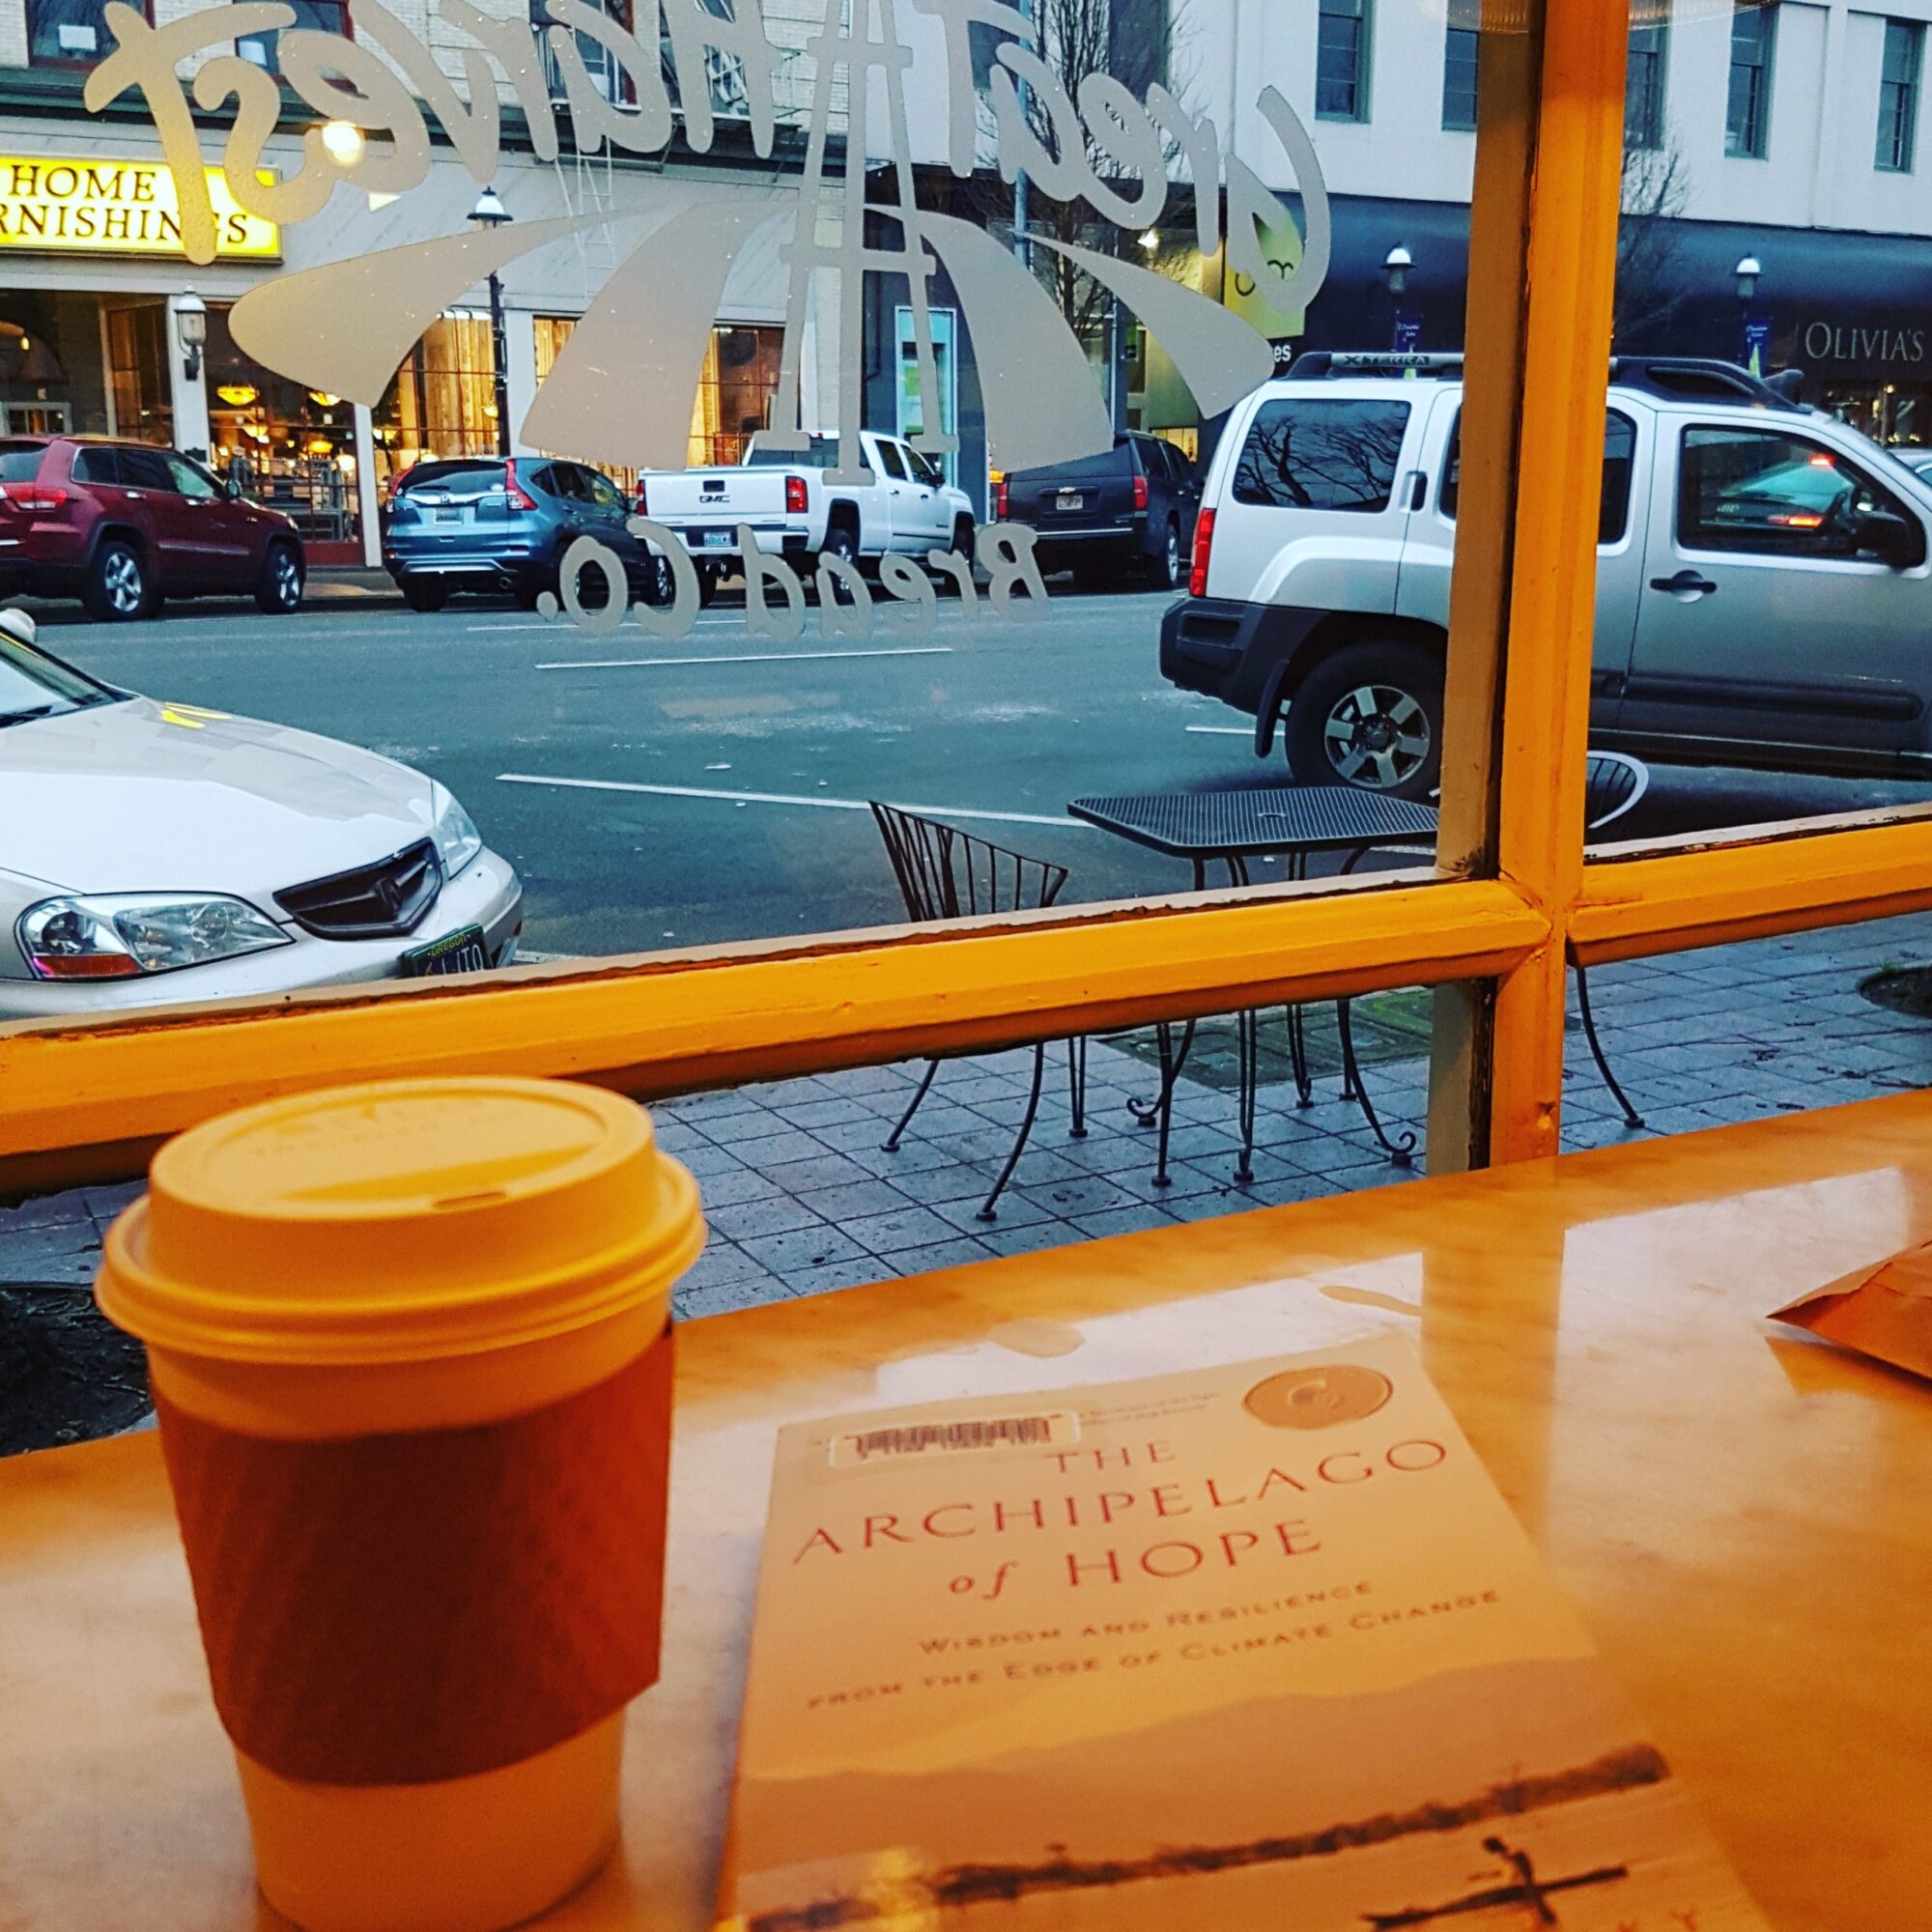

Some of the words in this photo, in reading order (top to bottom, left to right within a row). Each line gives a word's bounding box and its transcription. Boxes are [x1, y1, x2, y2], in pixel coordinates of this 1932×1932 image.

[9, 164, 157, 203] HOME
[1804, 322, 1924, 362] OLIVIA'S
[699, 495, 730, 503] GMC
[431, 933, 468, 957] OREGON
[1043, 1441, 1176, 1474] THE
[791, 1438, 1448, 1566] ARCHIPELAGO
[948, 1559, 1019, 1610] of
[1065, 1519, 1322, 1587] HOPE
